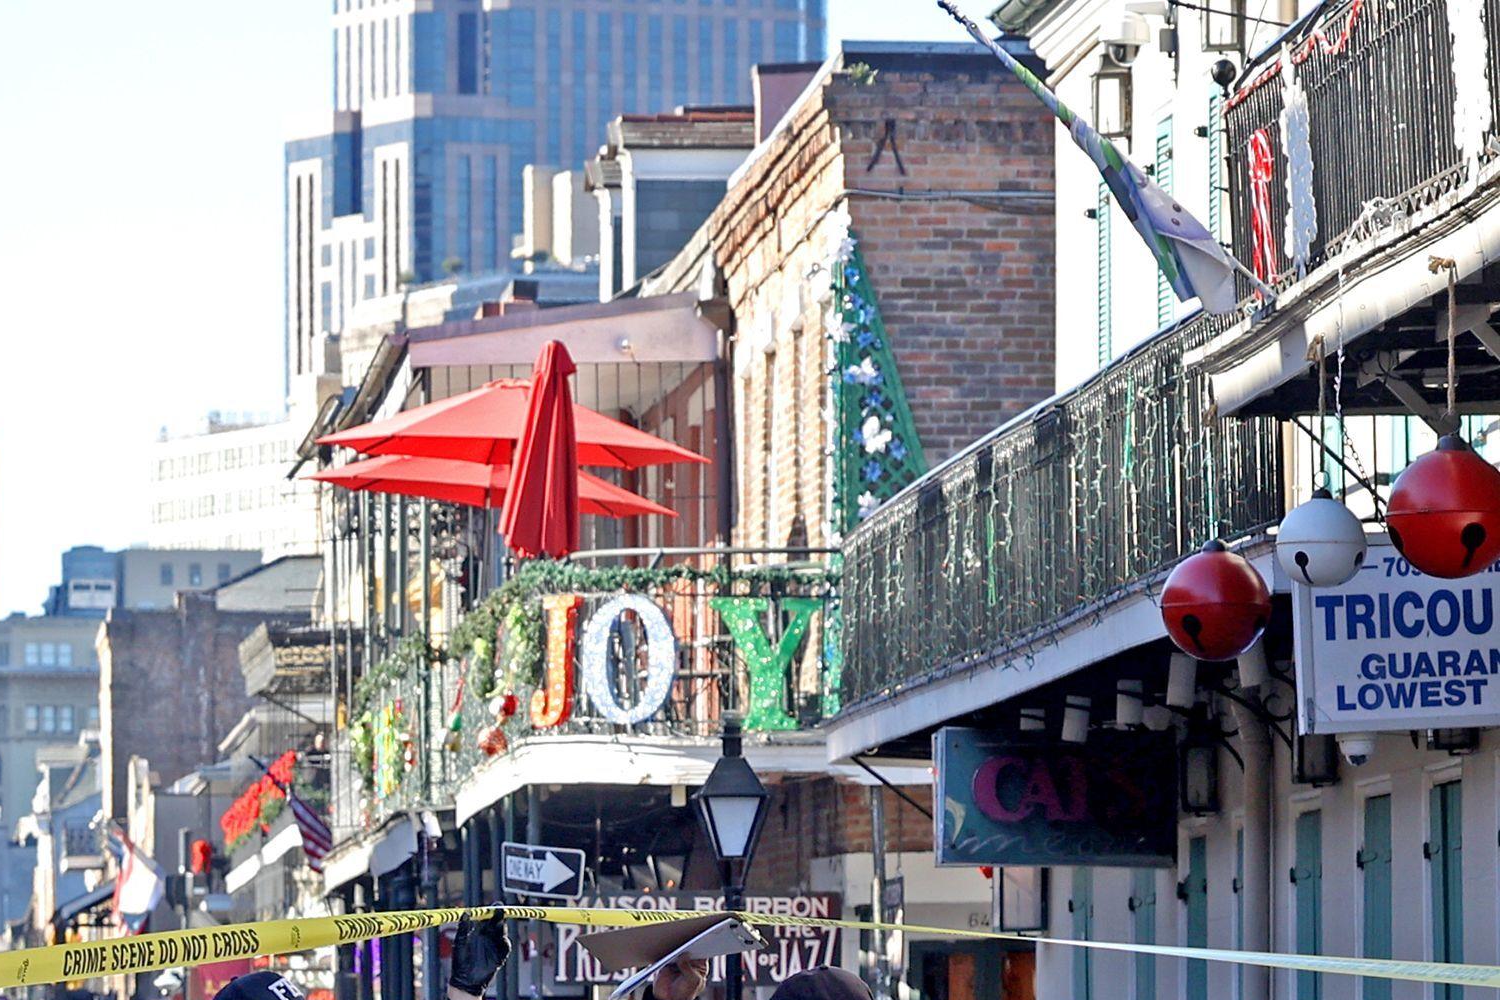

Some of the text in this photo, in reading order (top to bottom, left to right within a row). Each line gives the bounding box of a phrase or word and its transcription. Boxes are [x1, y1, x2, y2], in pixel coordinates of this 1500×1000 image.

[1315, 588, 1494, 641] TRICOU
[530, 593, 824, 730] JOY
[1336, 678, 1489, 711] LOWEST
[524, 861, 544, 880] WAY
[566, 895, 678, 917] MAISON
[334, 918, 384, 940] CRIME
[389, 911, 434, 932] SCENE
[63, 946, 107, 976] CRIME
[111, 941, 154, 971] SCENE
[158, 938, 177, 965] DO
[181, 934, 209, 962] NOT
[212, 928, 260, 958] CROSS
[757, 953, 779, 967] OF
